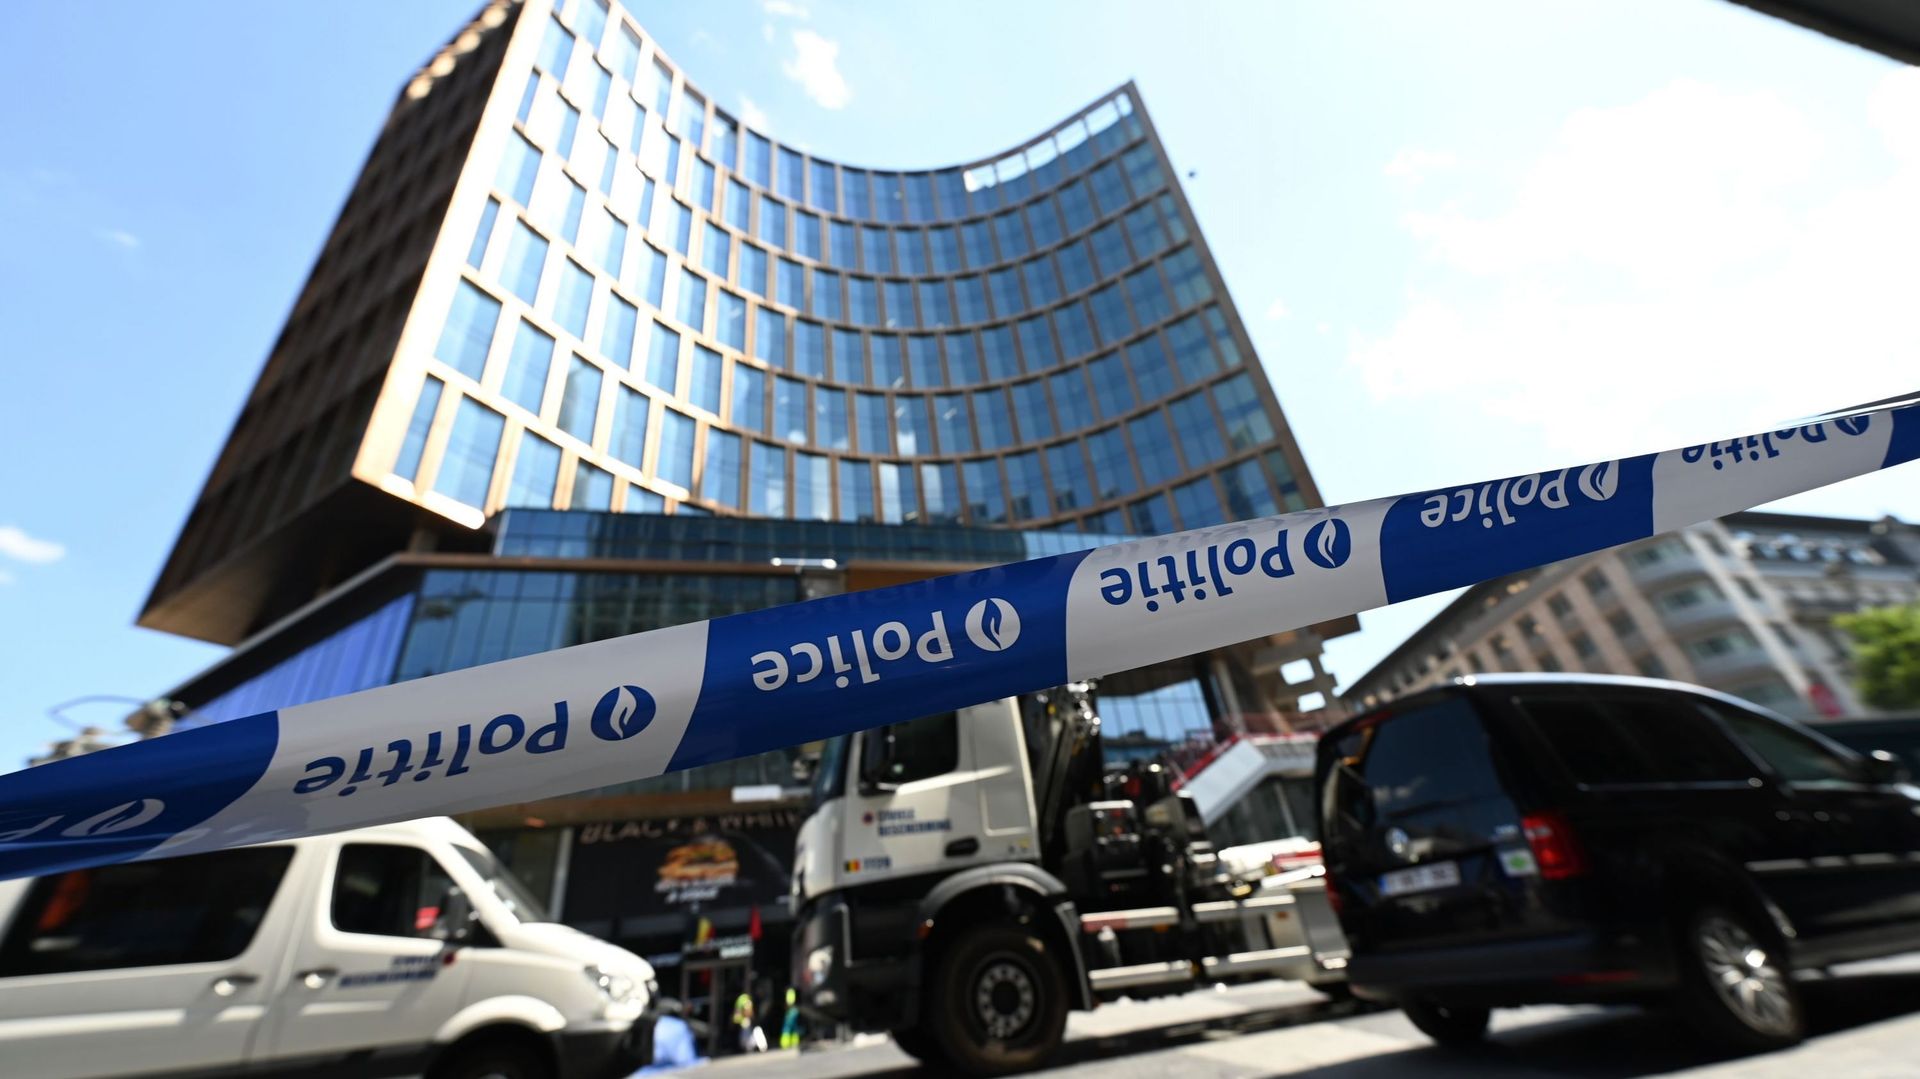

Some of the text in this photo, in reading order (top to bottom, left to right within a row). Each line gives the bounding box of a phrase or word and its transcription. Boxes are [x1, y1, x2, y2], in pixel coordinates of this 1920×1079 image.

[1420, 466, 1571, 528] Police
[1100, 529, 1295, 612] Politie
[750, 610, 954, 691] Police
[293, 700, 569, 797] Politie
